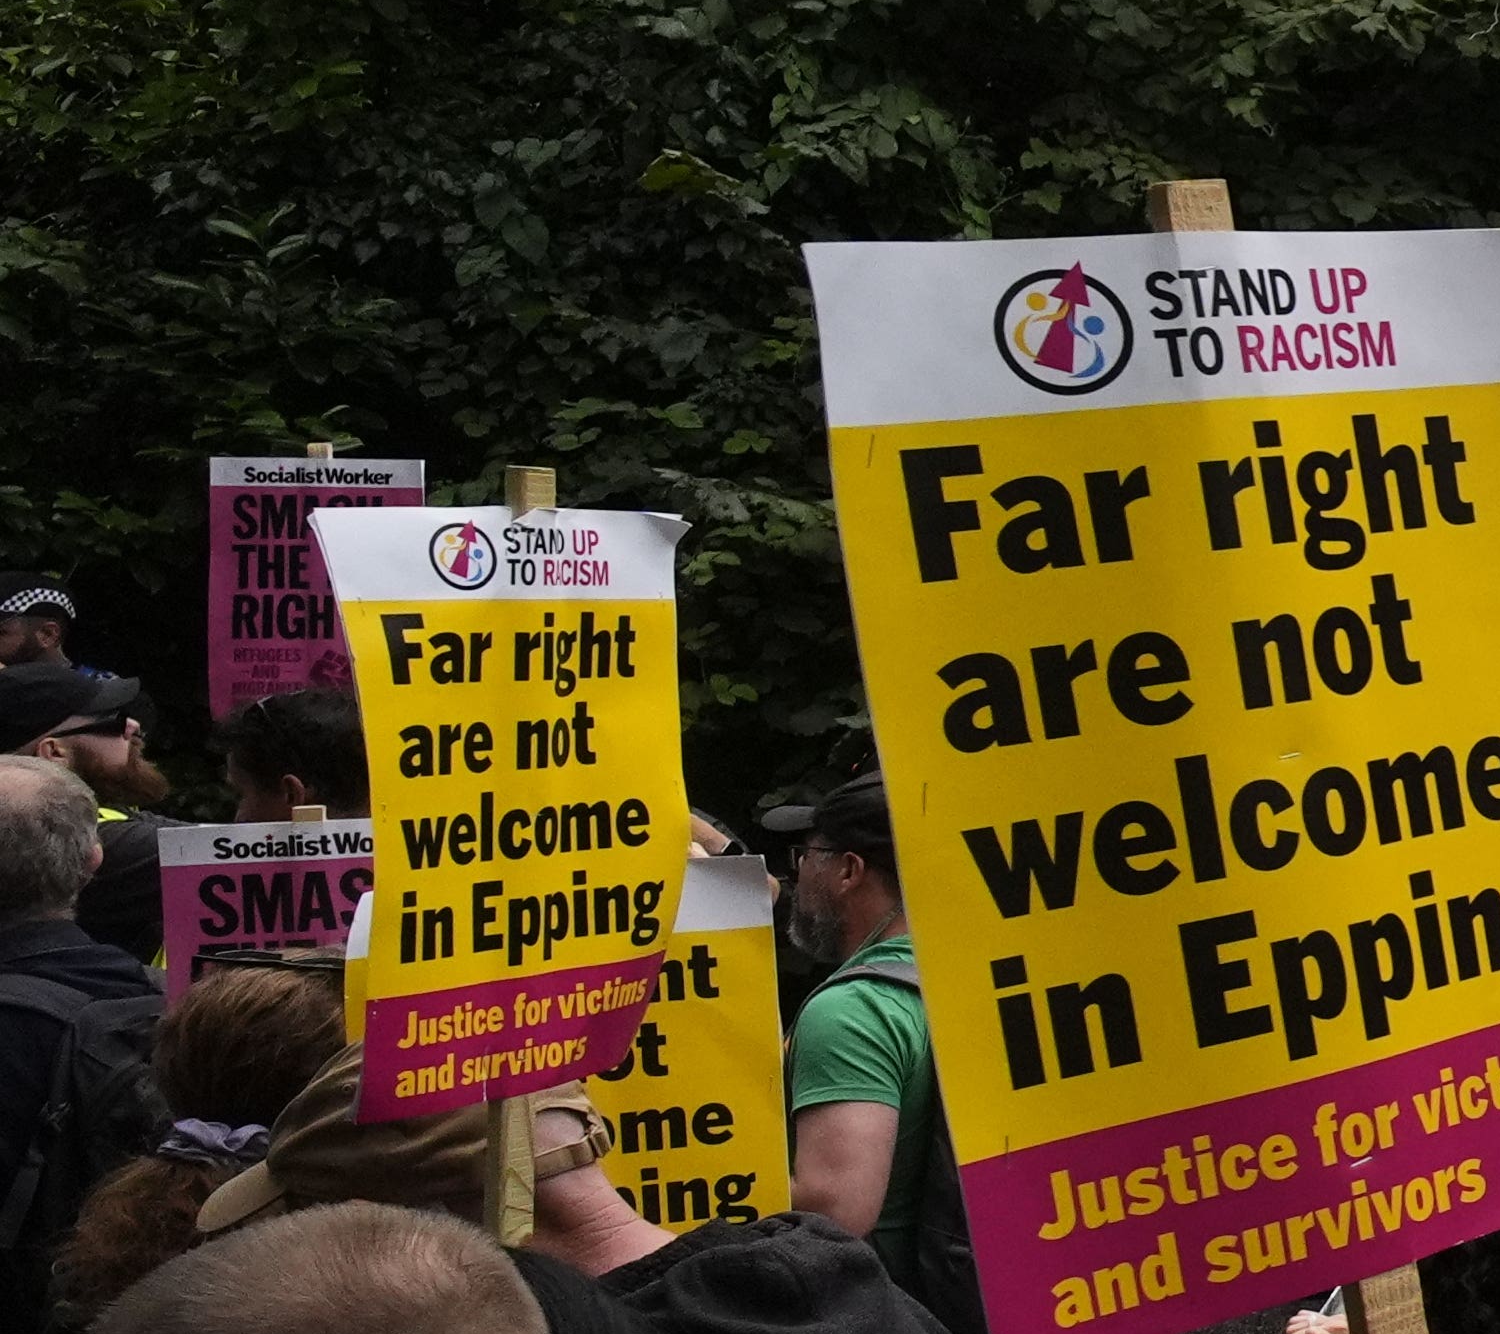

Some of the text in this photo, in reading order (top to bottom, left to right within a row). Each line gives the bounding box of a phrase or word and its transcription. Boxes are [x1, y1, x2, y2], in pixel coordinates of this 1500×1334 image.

[1145, 268, 1367, 320] STAND UP
[1153, 321, 1396, 377] TO RACISM
[244, 467, 393, 485] Socialist Worker
[900, 414, 1475, 583] Far right
[231, 544, 310, 589] THE
[503, 528, 599, 555] STAND UP
[508, 558, 609, 586] TO RACISM
[231, 594, 335, 640] RIGH
[234, 647, 300, 663] REFUGEES
[380, 612, 635, 697] Far right
[936, 574, 1422, 753] are not
[399, 702, 596, 779] are not
[213, 835, 331, 859] Socialist
[401, 792, 649, 869] welcome
[199, 868, 374, 937] SMAS
[401, 870, 663, 966] in Epping
[397, 976, 647, 1049] Justice for victims
[994, 955, 1142, 1090] in
[395, 1054, 454, 1098] and
[461, 1034, 587, 1087] survivors
[1039, 1133, 1297, 1240] Justice
[1314, 1100, 1399, 1168] for
[1051, 1157, 1487, 1330] and survivors
